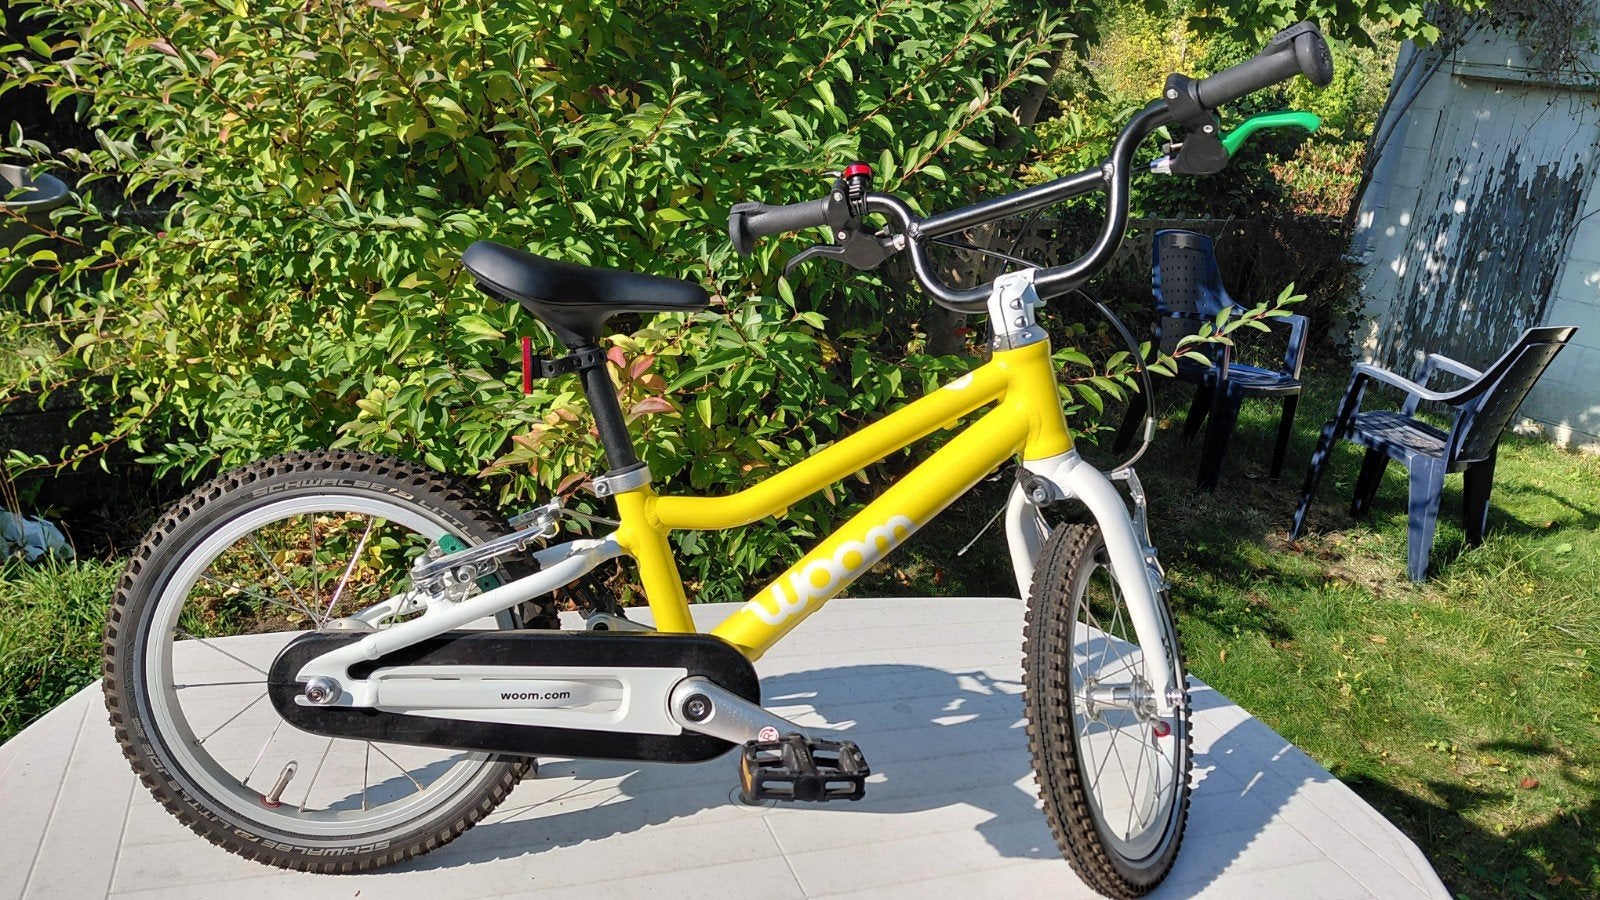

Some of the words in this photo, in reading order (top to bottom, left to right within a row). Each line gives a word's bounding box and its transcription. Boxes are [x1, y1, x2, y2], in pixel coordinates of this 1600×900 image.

[252, 478, 386, 497] SCHWALBE
[741, 515, 916, 625] woom
[500, 689, 571, 701] woom.com
[260, 838, 391, 857] SCHWALBE
